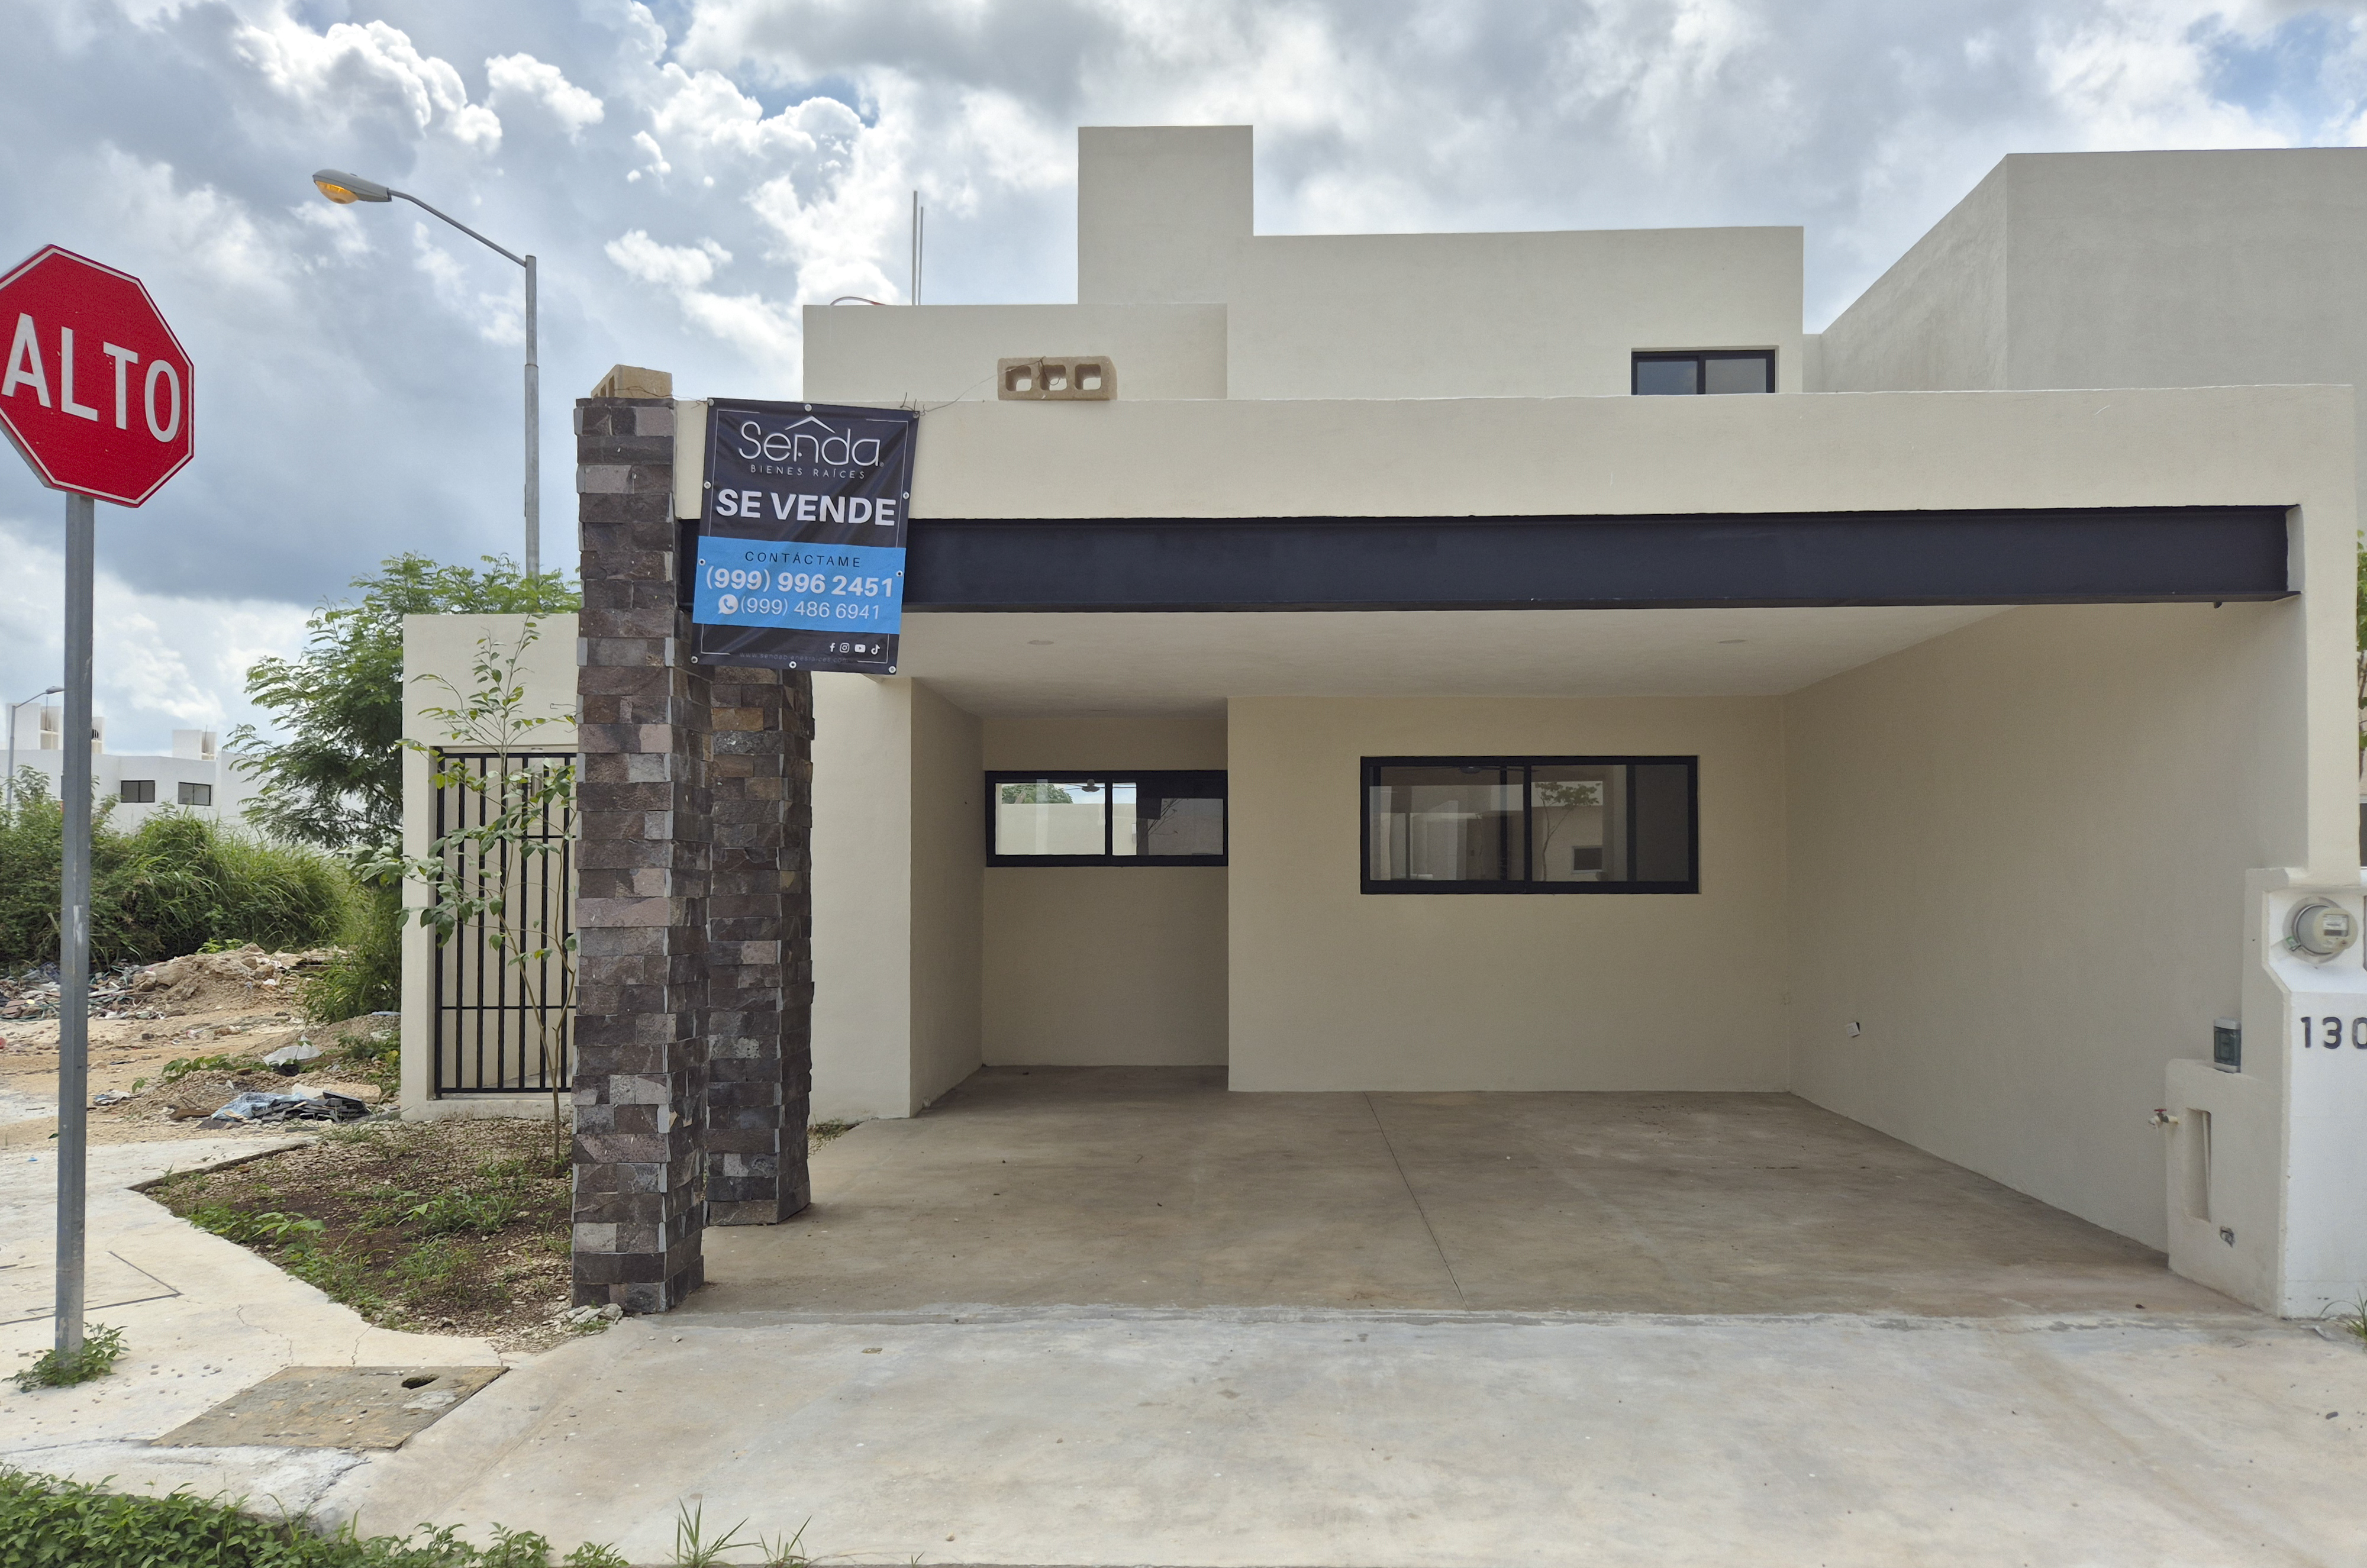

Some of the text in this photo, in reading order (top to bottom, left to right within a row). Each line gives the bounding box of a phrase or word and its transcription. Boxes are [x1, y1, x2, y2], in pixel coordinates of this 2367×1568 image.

[1, 312, 180, 442] ALTO
[739, 421, 880, 466] Senda
[750, 464, 865, 479] BIENES RAÍCES
[716, 489, 896, 526] SE VENDE
[745, 551, 860, 567] CONTÁCTAME
[707, 566, 892, 598] (999) 996 2451
[741, 595, 879, 620] (999) 486 6941
